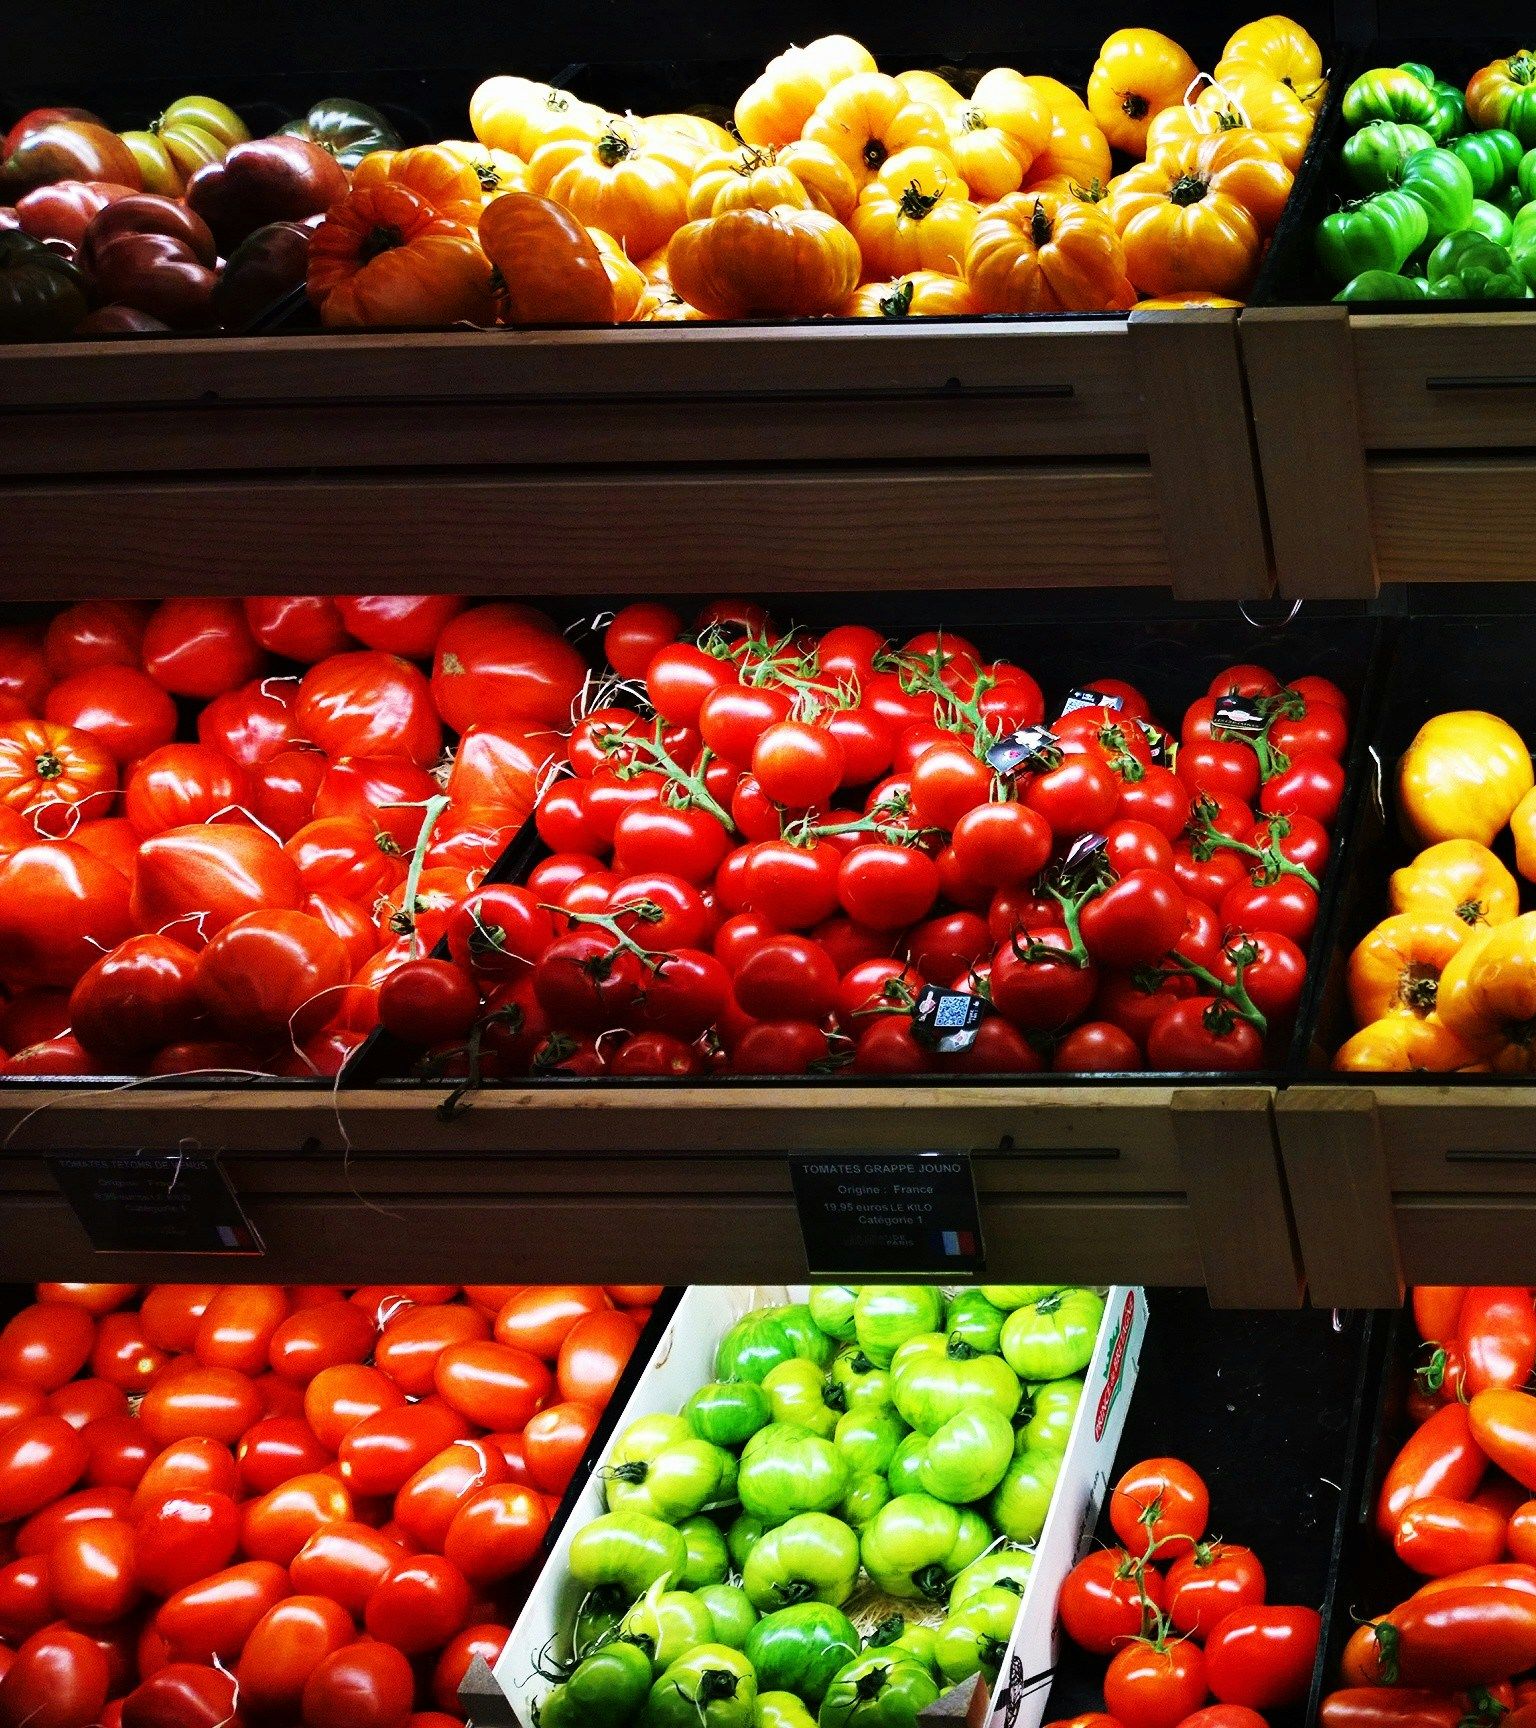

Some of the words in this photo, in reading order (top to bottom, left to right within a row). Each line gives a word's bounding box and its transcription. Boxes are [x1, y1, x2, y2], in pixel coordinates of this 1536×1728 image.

[803, 1165, 861, 1174] TOMATES
[865, 1164, 914, 1174] GRAPPE
[919, 1164, 961, 1173] JOUNO
[838, 1185, 880, 1196] Origine
[894, 1185, 934, 1195] France
[856, 1204, 888, 1212] euros
[891, 1204, 903, 1212] LE
[908, 1204, 933, 1212] KILO
